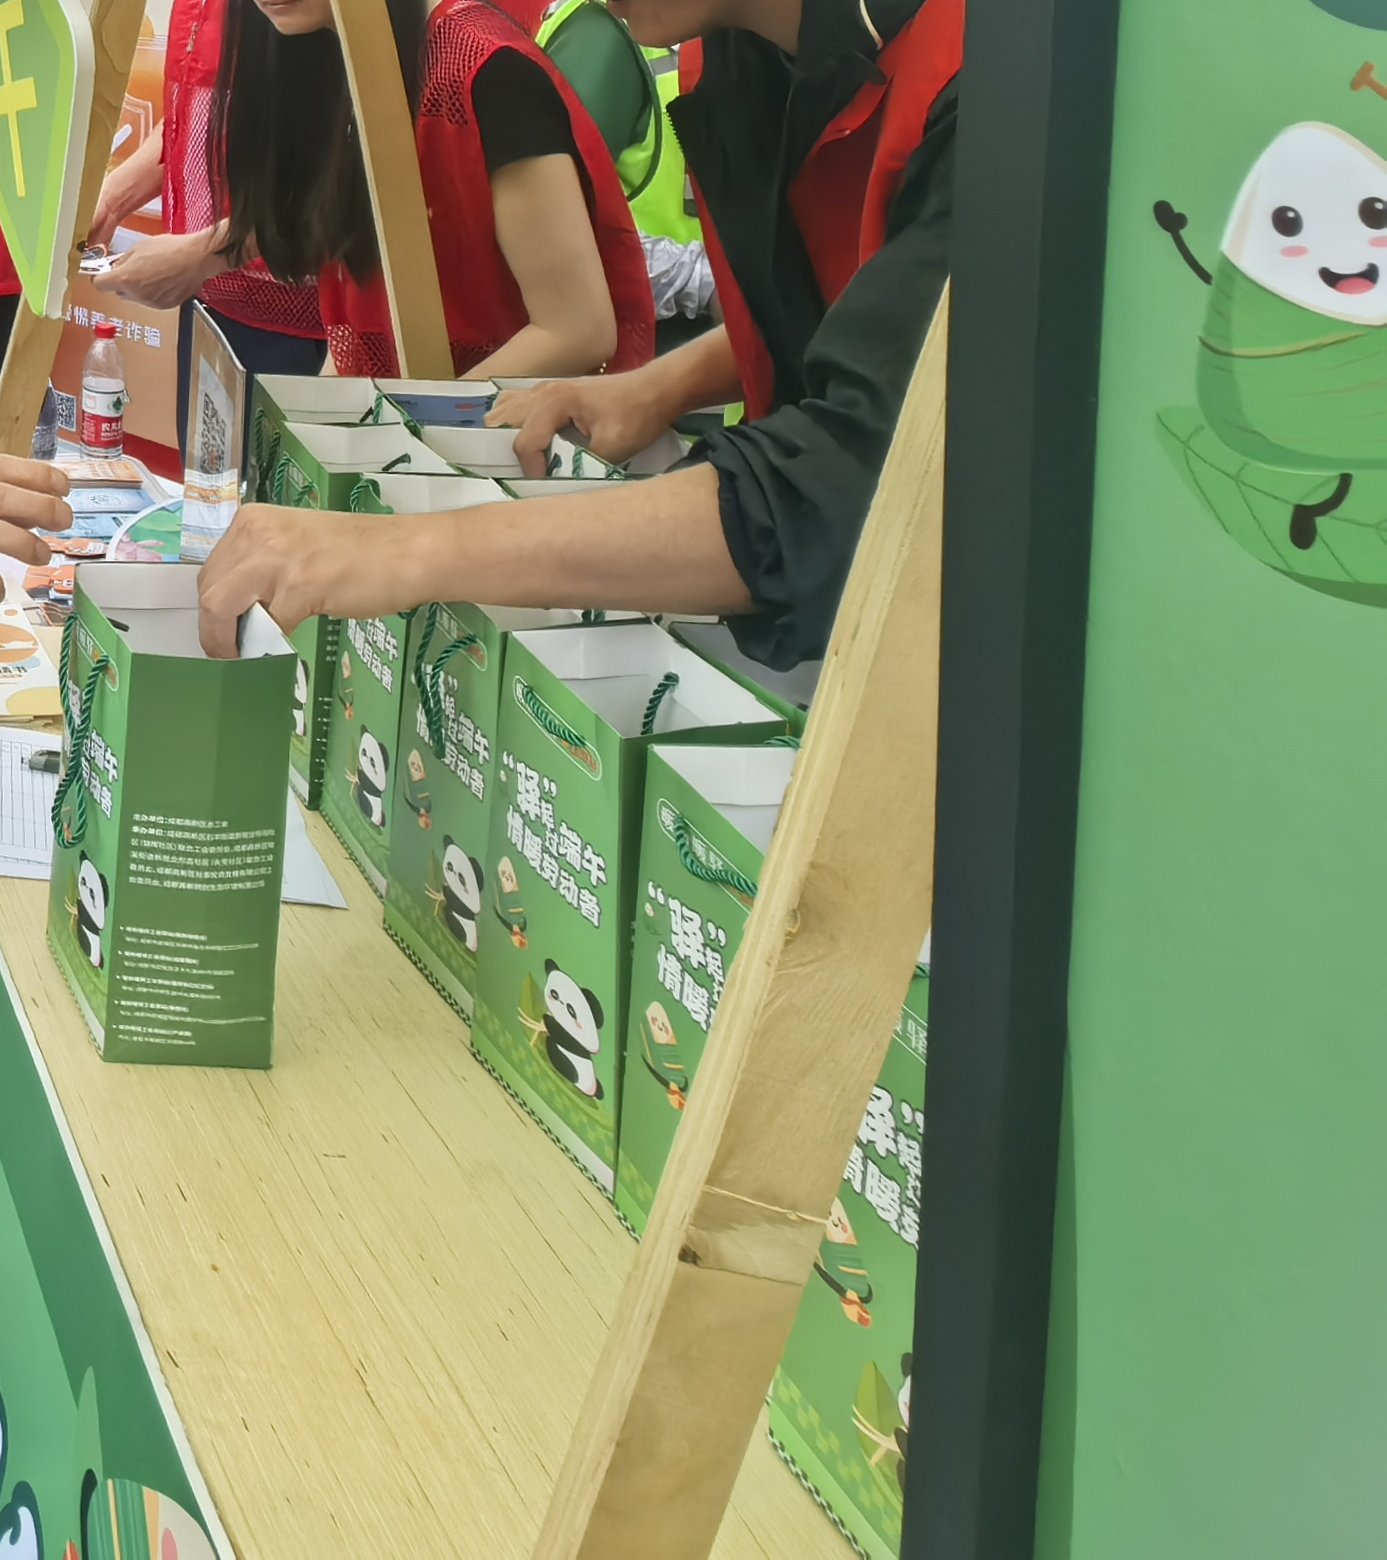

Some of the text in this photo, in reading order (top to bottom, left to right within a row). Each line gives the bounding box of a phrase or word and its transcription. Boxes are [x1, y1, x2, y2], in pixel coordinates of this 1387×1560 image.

[507, 804, 602, 928] 情暖劳动者
